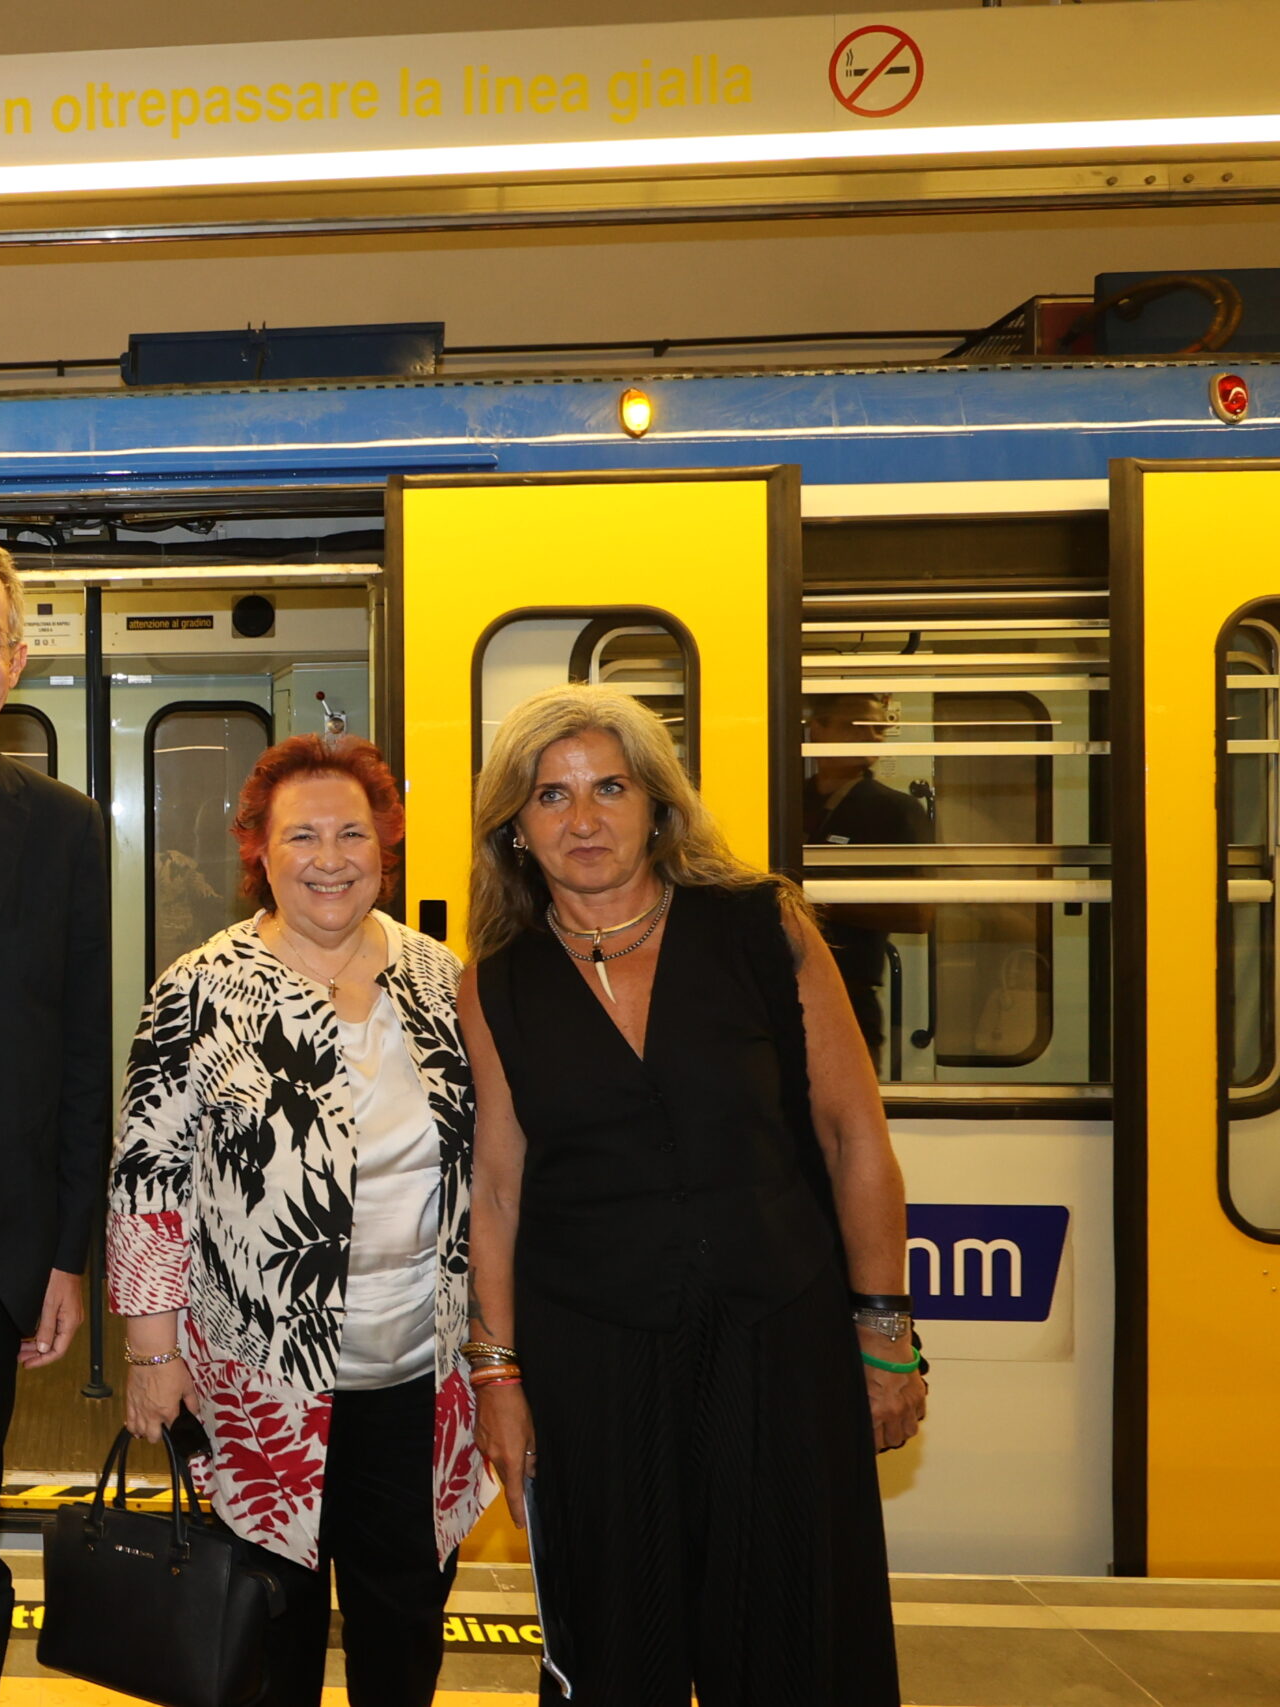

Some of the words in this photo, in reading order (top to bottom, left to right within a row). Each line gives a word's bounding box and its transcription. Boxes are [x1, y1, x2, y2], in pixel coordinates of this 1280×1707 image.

[51, 80, 379, 139] oltrepassare
[399, 66, 442, 118] la
[463, 64, 589, 115] linea
[607, 53, 753, 125] gialla
[128, 620, 170, 629] attenzione
[181, 618, 212, 629] gradino
